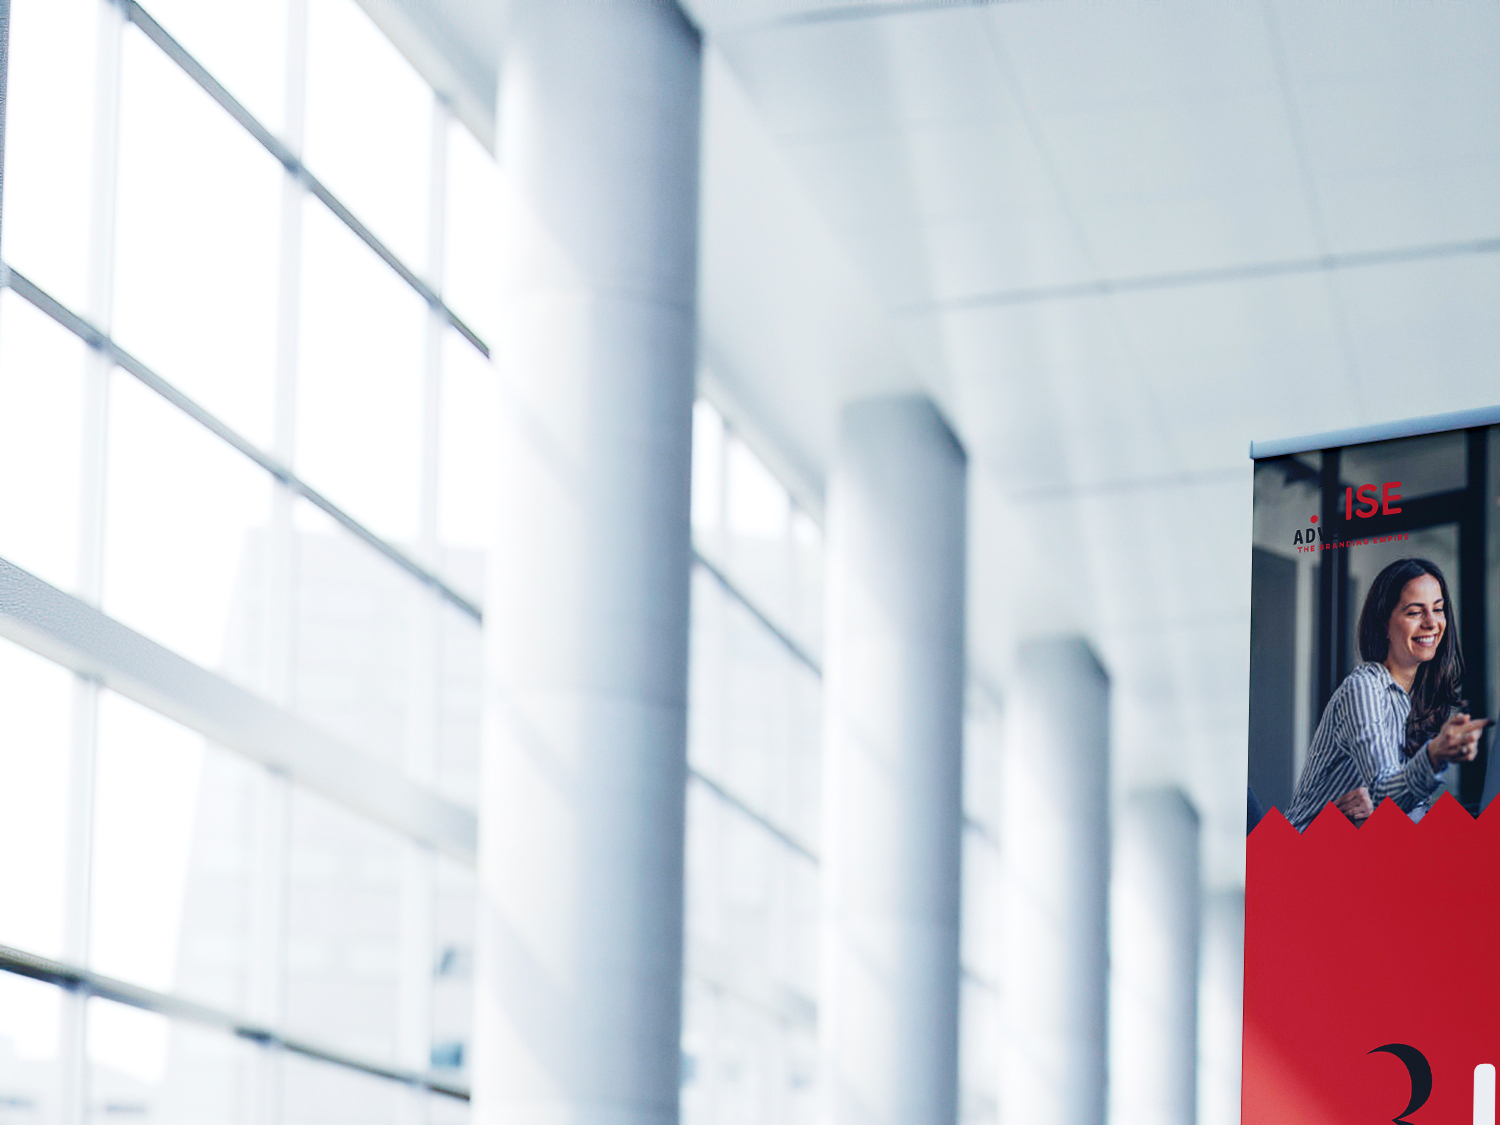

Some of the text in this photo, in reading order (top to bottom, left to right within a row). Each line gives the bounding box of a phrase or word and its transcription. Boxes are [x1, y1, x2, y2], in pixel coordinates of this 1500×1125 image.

[1297, 533, 1409, 553] THE BRANDING EMPIRE
